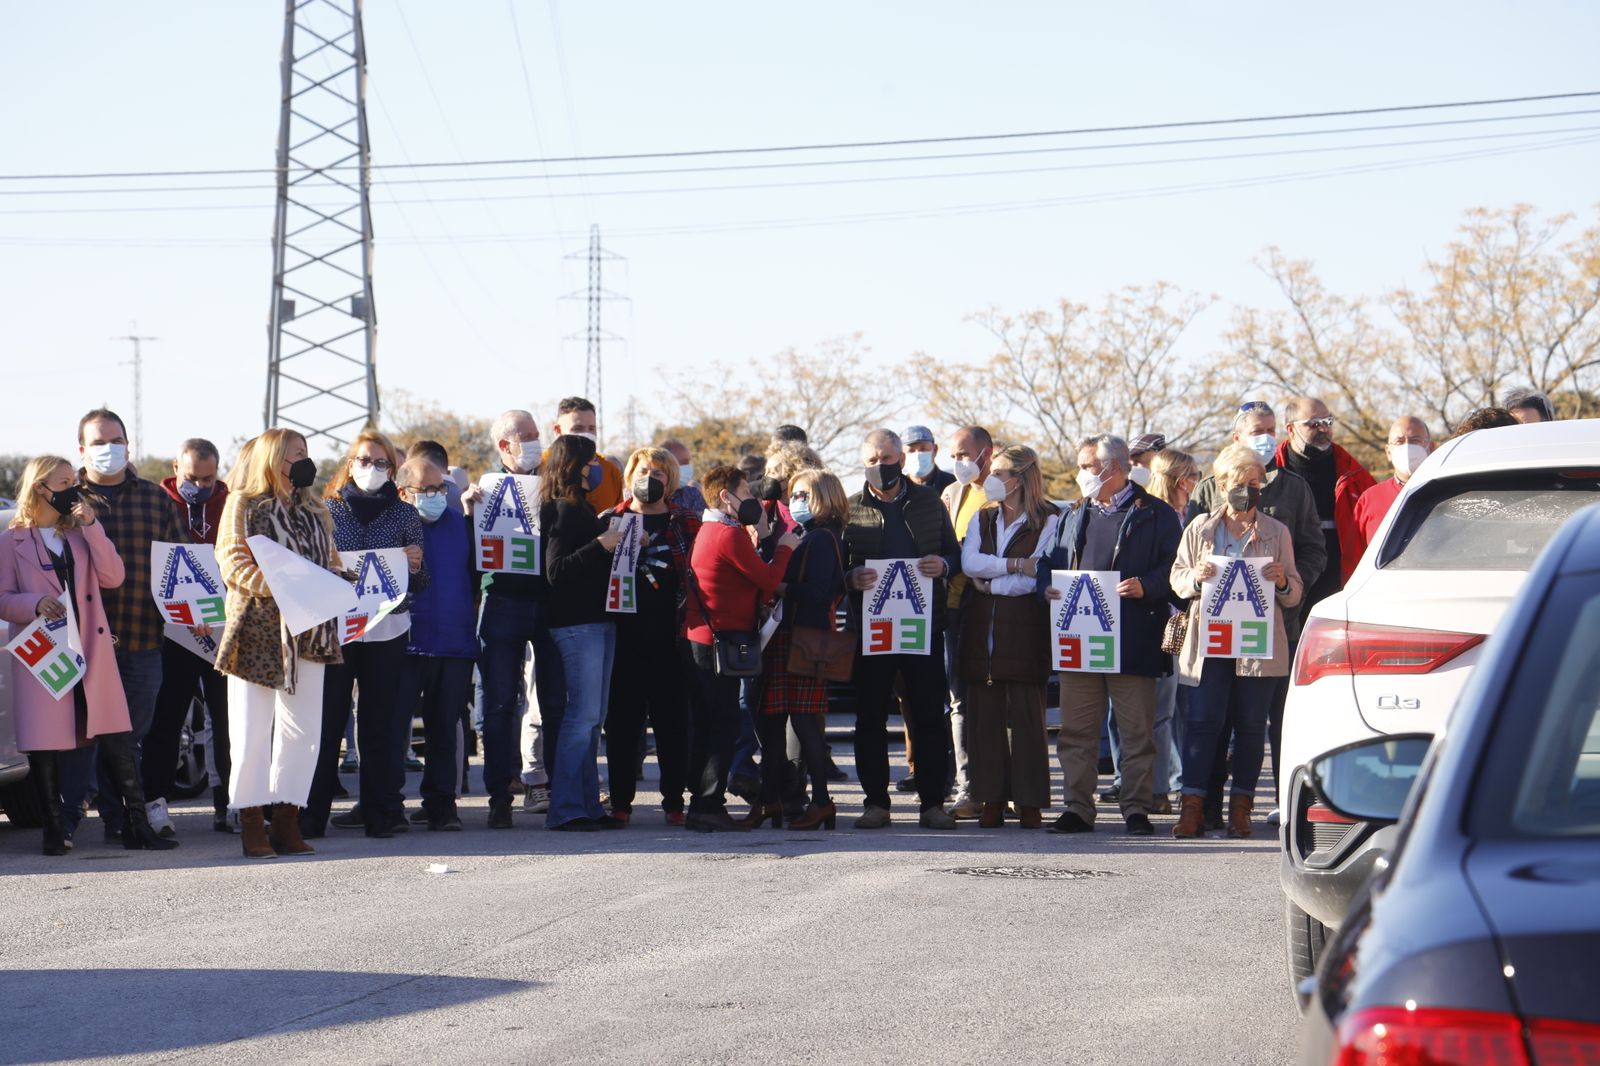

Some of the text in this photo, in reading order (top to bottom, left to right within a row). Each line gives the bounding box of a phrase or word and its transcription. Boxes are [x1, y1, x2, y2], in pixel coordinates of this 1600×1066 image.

[479, 478, 504, 529] PLATAFORMA
[516, 481, 536, 529] CIUDADANA
[159, 547, 176, 597] PLATAFORMA
[187, 550, 219, 590] CIUDADANA
[867, 562, 895, 613] PLATAFORMA
[906, 563, 927, 609] CIUDADANA
[1206, 561, 1234, 614] PLATAFORMA
[1247, 564, 1269, 611] CIUDADANA
[1056, 575, 1080, 628] PLATAFORMA
[1092, 577, 1115, 626] CIUDADANA
[1376, 694, 1421, 710] Q3
